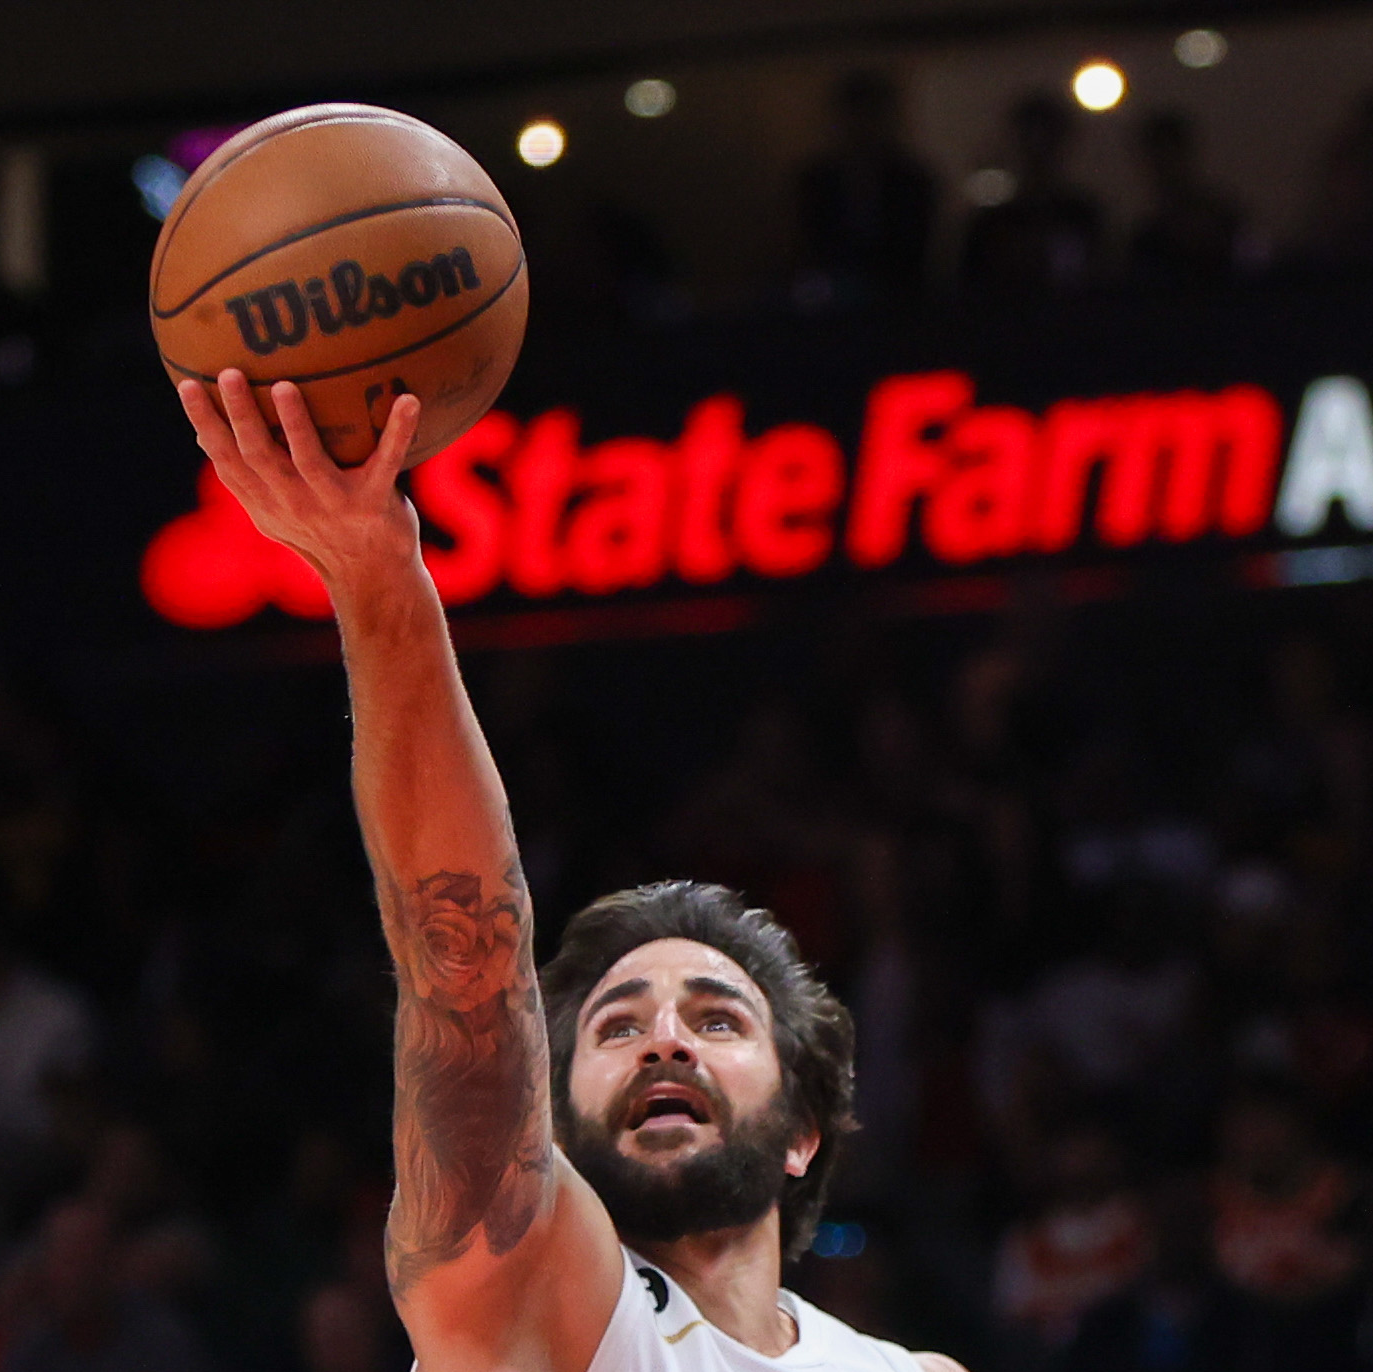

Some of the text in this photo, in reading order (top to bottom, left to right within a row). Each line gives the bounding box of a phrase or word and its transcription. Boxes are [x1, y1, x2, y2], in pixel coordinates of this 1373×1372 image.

[225, 246, 482, 356] Wilson
[410, 393, 846, 607] State
[846, 369, 1283, 570] Farm
